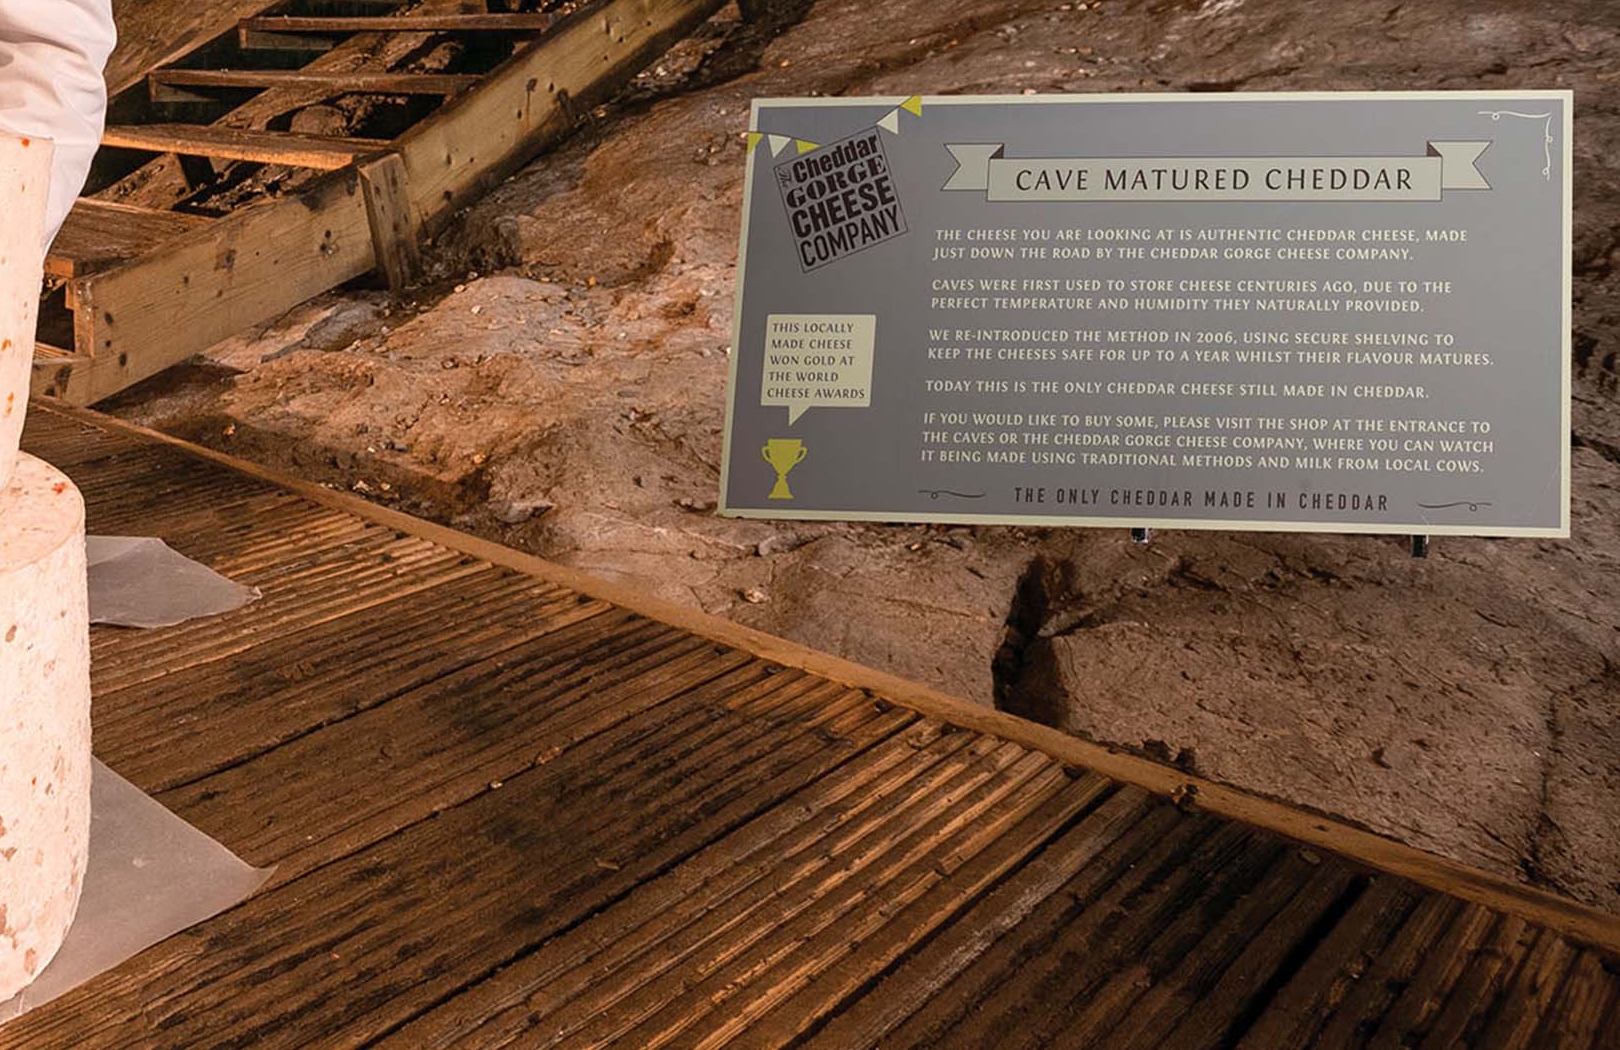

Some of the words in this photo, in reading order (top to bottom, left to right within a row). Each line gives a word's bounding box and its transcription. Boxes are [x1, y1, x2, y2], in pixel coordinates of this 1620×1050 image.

[792, 134, 879, 184] Cheddar
[785, 154, 887, 208] GORGE
[1016, 168, 1088, 192] CAVE
[1104, 167, 1249, 192] MATURED
[1265, 167, 1413, 191] CHEDDAR
[791, 175, 896, 238] CHEESE
[799, 204, 899, 267] COMPANY
[936, 228, 961, 241] THE
[966, 228, 1016, 241] CHEESE
[1022, 228, 1050, 241] YOU
[1055, 228, 1081, 241] ARE
[1087, 228, 1151, 241] LOOKING
[1155, 228, 1174, 241] AT
[1179, 228, 1192, 241] IS
[1197, 228, 1281, 242] AUTHENTIC
[1286, 228, 1356, 242] CHEDDAR
[1361, 228, 1419, 244] CHEESE,
[1425, 228, 1466, 242] MADE
[932, 247, 965, 260] JUST
[970, 247, 1014, 260] DOWN
[1020, 247, 1046, 260] THE
[1052, 247, 1090, 260] ROAD
[1096, 247, 1112, 260] BY
[1117, 247, 1144, 260] THE
[1150, 247, 1218, 260] CHEDDAR
[1223, 247, 1271, 260] GORGE
[1277, 247, 1330, 260] CHEESE
[1336, 247, 1412, 260] COMPANY.
[932, 278, 974, 291] CAVES
[979, 278, 1016, 291] WERE
[1022, 279, 1060, 292] FIRST
[1066, 279, 1101, 292] USED
[1106, 279, 1125, 292] TO
[1130, 279, 1173, 292] STORE
[1179, 279, 1231, 293] CHEESE
[1236, 280, 1317, 293] CENTURIES
[1322, 280, 1357, 295] AGO,
[1363, 280, 1391, 294] DUE
[1398, 281, 1417, 294] TO
[1424, 281, 1450, 294] THE
[931, 297, 988, 310] PERFECT
[993, 297, 1092, 311] TEMPERATURE
[1097, 298, 1128, 311] AND
[1134, 298, 1208, 312] HUMIDITY
[1213, 299, 1250, 312] THEY
[1256, 299, 1340, 312] NATURALLY
[1346, 300, 1424, 313] PROVIDED.
[772, 323, 799, 333] THIS
[804, 323, 854, 333] LOCALLY
[928, 329, 948, 342] WE
[955, 329, 1068, 343] RE-INTRODUCED
[1074, 330, 1100, 343] THE
[1107, 330, 1169, 344] METHOD
[1174, 331, 1190, 344] IN
[1196, 331, 1237, 346] 2006,
[1243, 331, 1289, 345] USING
[1294, 332, 1348, 345] SECURE
[1354, 332, 1428, 346] SHELVING
[1434, 333, 1454, 346] TO
[771, 339, 805, 349] MADE
[809, 339, 852, 349] CHEESE
[770, 355, 799, 365] WON
[804, 356, 835, 366] GOLD
[840, 356, 855, 366] AT
[928, 347, 960, 360] KEEP
[965, 347, 992, 361] THE
[997, 348, 1056, 361] CHEESES
[1061, 348, 1093, 362] SAFE
[1099, 349, 1125, 362] FOR
[1132, 349, 1150, 362] UP
[1156, 349, 1174, 363] TO
[1179, 350, 1189, 363] A
[1194, 350, 1229, 363] YEAR
[1235, 350, 1291, 364] WHILST
[1297, 351, 1340, 364] THEIR
[1347, 351, 1413, 365] FLAVOUR
[1419, 352, 1493, 366] MATURES.
[769, 372, 791, 381] THE
[796, 372, 839, 382] WORLD
[767, 388, 810, 398] CHEESE
[814, 389, 865, 399] AWARDS
[926, 380, 971, 393] TODAY
[976, 381, 1008, 393] THIS
[1014, 381, 1026, 393] IS
[1031, 381, 1058, 394] THE
[1064, 382, 1102, 394] ONLY
[1107, 382, 1175, 395] CHEDDAR
[1180, 383, 1233, 396] CHEESE
[1239, 384, 1276, 397] STILL
[1283, 384, 1324, 397] MADE
[1331, 385, 1347, 398] IN
[1353, 385, 1428, 399] CHEDDAR.
[924, 413, 936, 426] IF
[940, 413, 967, 427] YOU
[972, 414, 1023, 427] WOULD
[1028, 414, 1056, 428] LIKE
[1061, 415, 1080, 428] TO
[1085, 415, 1112, 429] BUY
[1116, 416, 1158, 431] SOME,
[1163, 416, 1210, 430] PLEASE
[1215, 417, 1252, 431] VISIT
[1257, 418, 1284, 431] THE
[1290, 418, 1328, 432] SHOP
[1332, 419, 1350, 432] AT
[1356, 419, 1383, 432] THE
[1390, 420, 1465, 434] ENTRANCE
[1471, 421, 1490, 434] TO
[922, 431, 948, 444] THE
[952, 431, 994, 445] CAVES
[998, 432, 1018, 445] OR
[1022, 433, 1048, 446] THE
[1054, 433, 1120, 447] CHEDDAR
[1124, 434, 1170, 448] GORGE
[1176, 435, 1226, 449] CHEESE
[1232, 436, 1308, 452] COMPANY,
[1312, 437, 1363, 451] WHERE
[1368, 438, 1398, 451] YOU
[1403, 439, 1434, 452] CAN
[1439, 439, 1493, 453] WATCH
[921, 449, 934, 462] IT
[939, 449, 980, 463] BEING
[986, 450, 1026, 464] MADE
[1032, 451, 1075, 465] USING
[1082, 452, 1176, 466] TRADITIONAL
[1182, 454, 1252, 468] METHODS
[1258, 455, 1289, 468] AND
[1295, 456, 1331, 469] MILK
[1338, 456, 1378, 470] FROM
[1385, 457, 1431, 471] LOCAL
[1436, 458, 1484, 472] COWS.
[1014, 487, 1044, 504] THE
[1056, 488, 1099, 505] ONLY
[1110, 489, 1192, 507] CHEDDAR
[1204, 491, 1254, 508] MADE
[1267, 492, 1286, 509] IN
[1299, 492, 1387, 511] CHEDDAR
